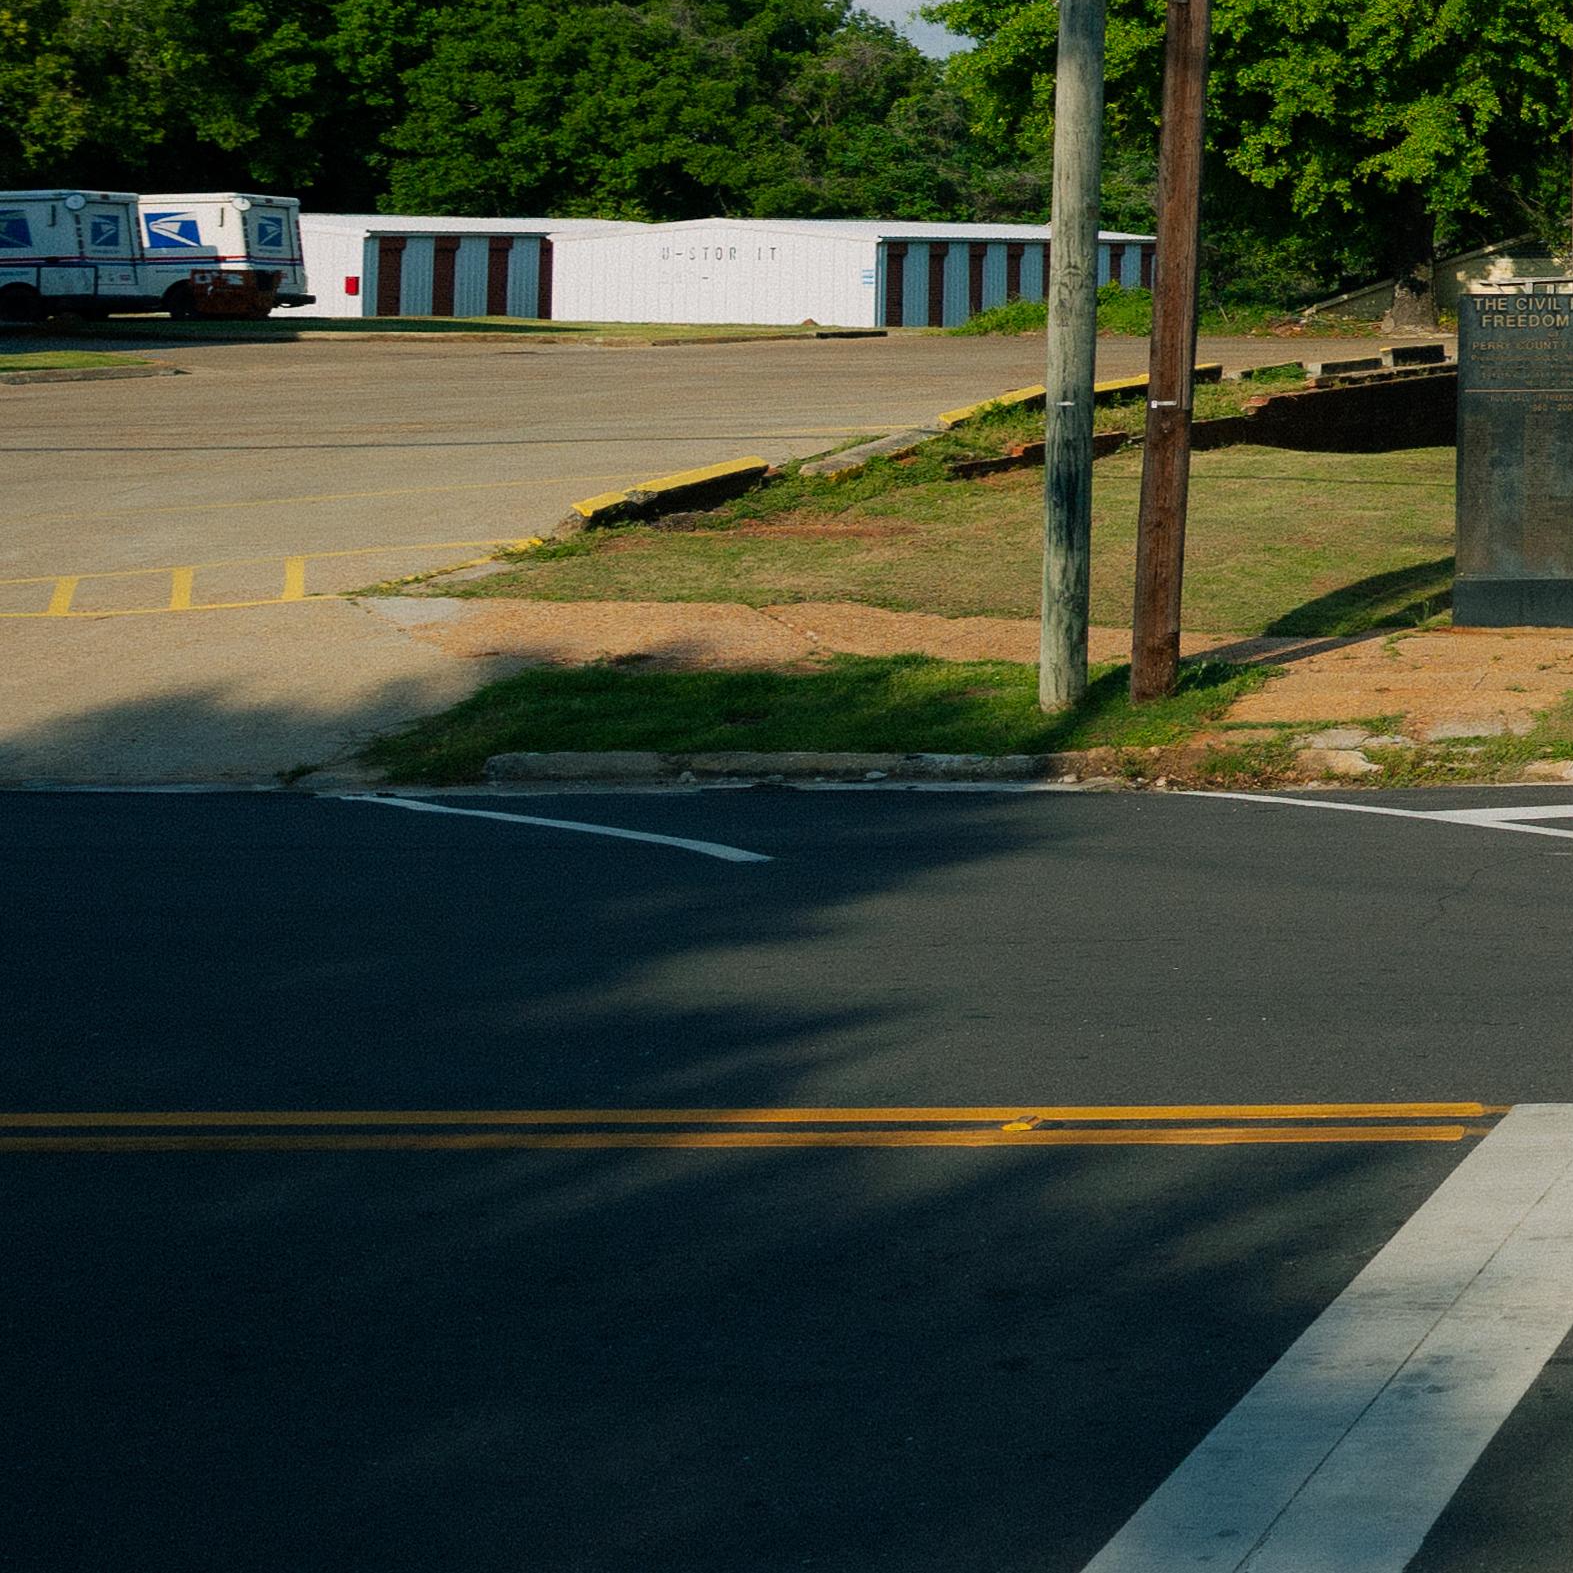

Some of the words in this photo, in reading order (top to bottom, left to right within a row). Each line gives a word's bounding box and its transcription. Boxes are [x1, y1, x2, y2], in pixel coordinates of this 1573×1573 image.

[661, 246, 737, 261] U-STOR
[757, 247, 777, 261] IT
[1473, 297, 1508, 311] THE
[1515, 297, 1562, 310] CIVIL
[1481, 314, 1570, 328] FREEDOM
[1472, 341, 1511, 350] PERRY
